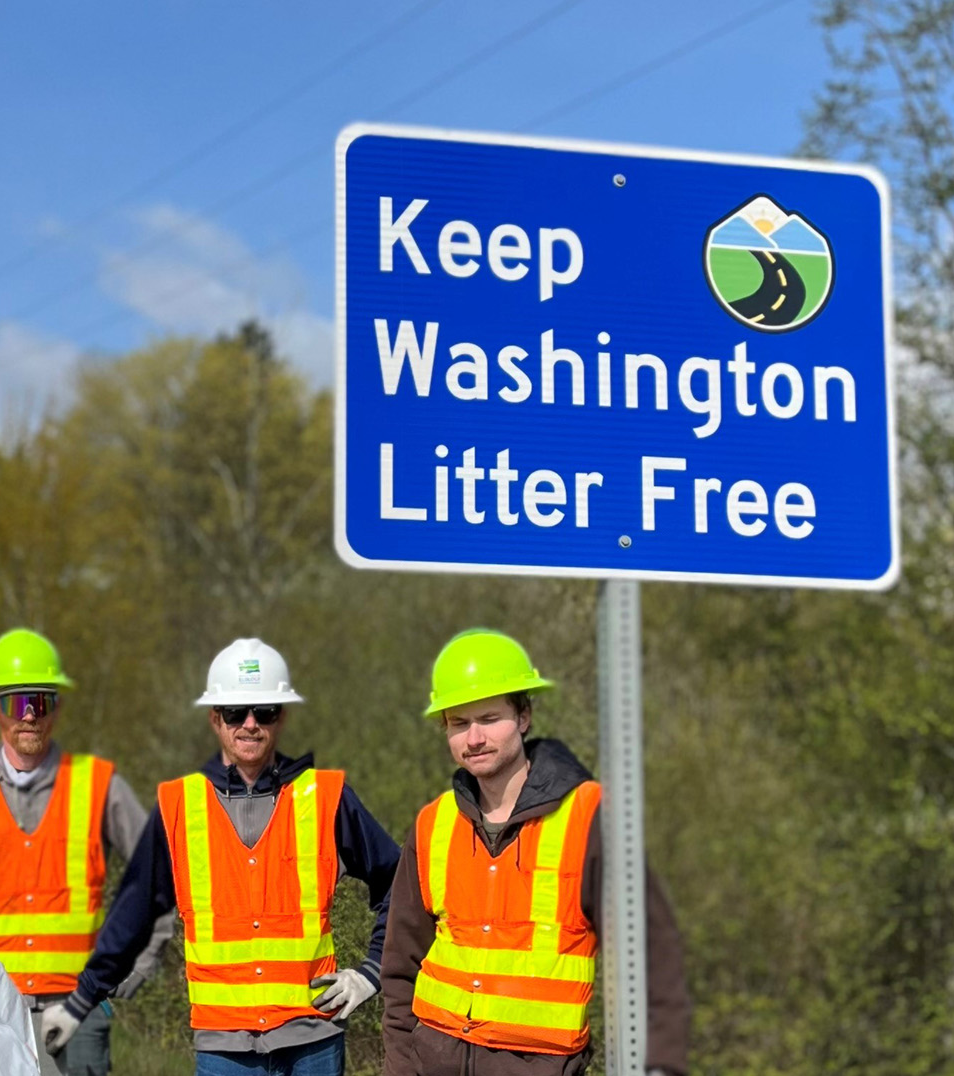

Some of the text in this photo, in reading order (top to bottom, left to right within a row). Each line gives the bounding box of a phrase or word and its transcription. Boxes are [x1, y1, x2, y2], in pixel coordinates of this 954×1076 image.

[379, 196, 584, 302] Keep
[374, 318, 857, 439] Washington
[379, 443, 817, 540] Litter Free
